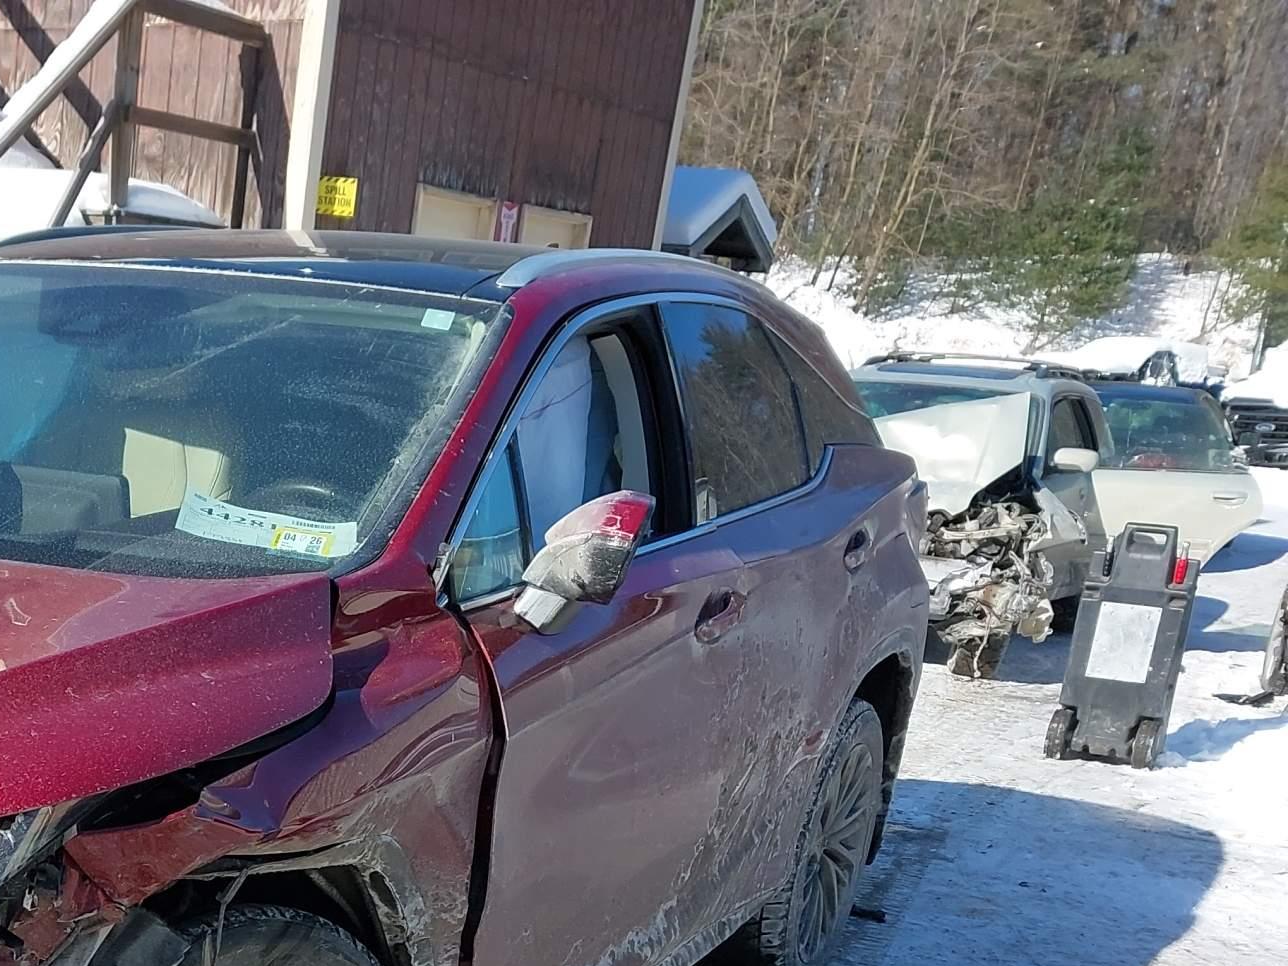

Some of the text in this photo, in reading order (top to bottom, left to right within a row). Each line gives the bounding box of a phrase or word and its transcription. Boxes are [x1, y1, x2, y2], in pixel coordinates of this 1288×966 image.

[325, 185, 346, 196] SPILL
[318, 195, 352, 208] STATION
[283, 532, 297, 542] 04
[309, 536, 322, 545] 26
